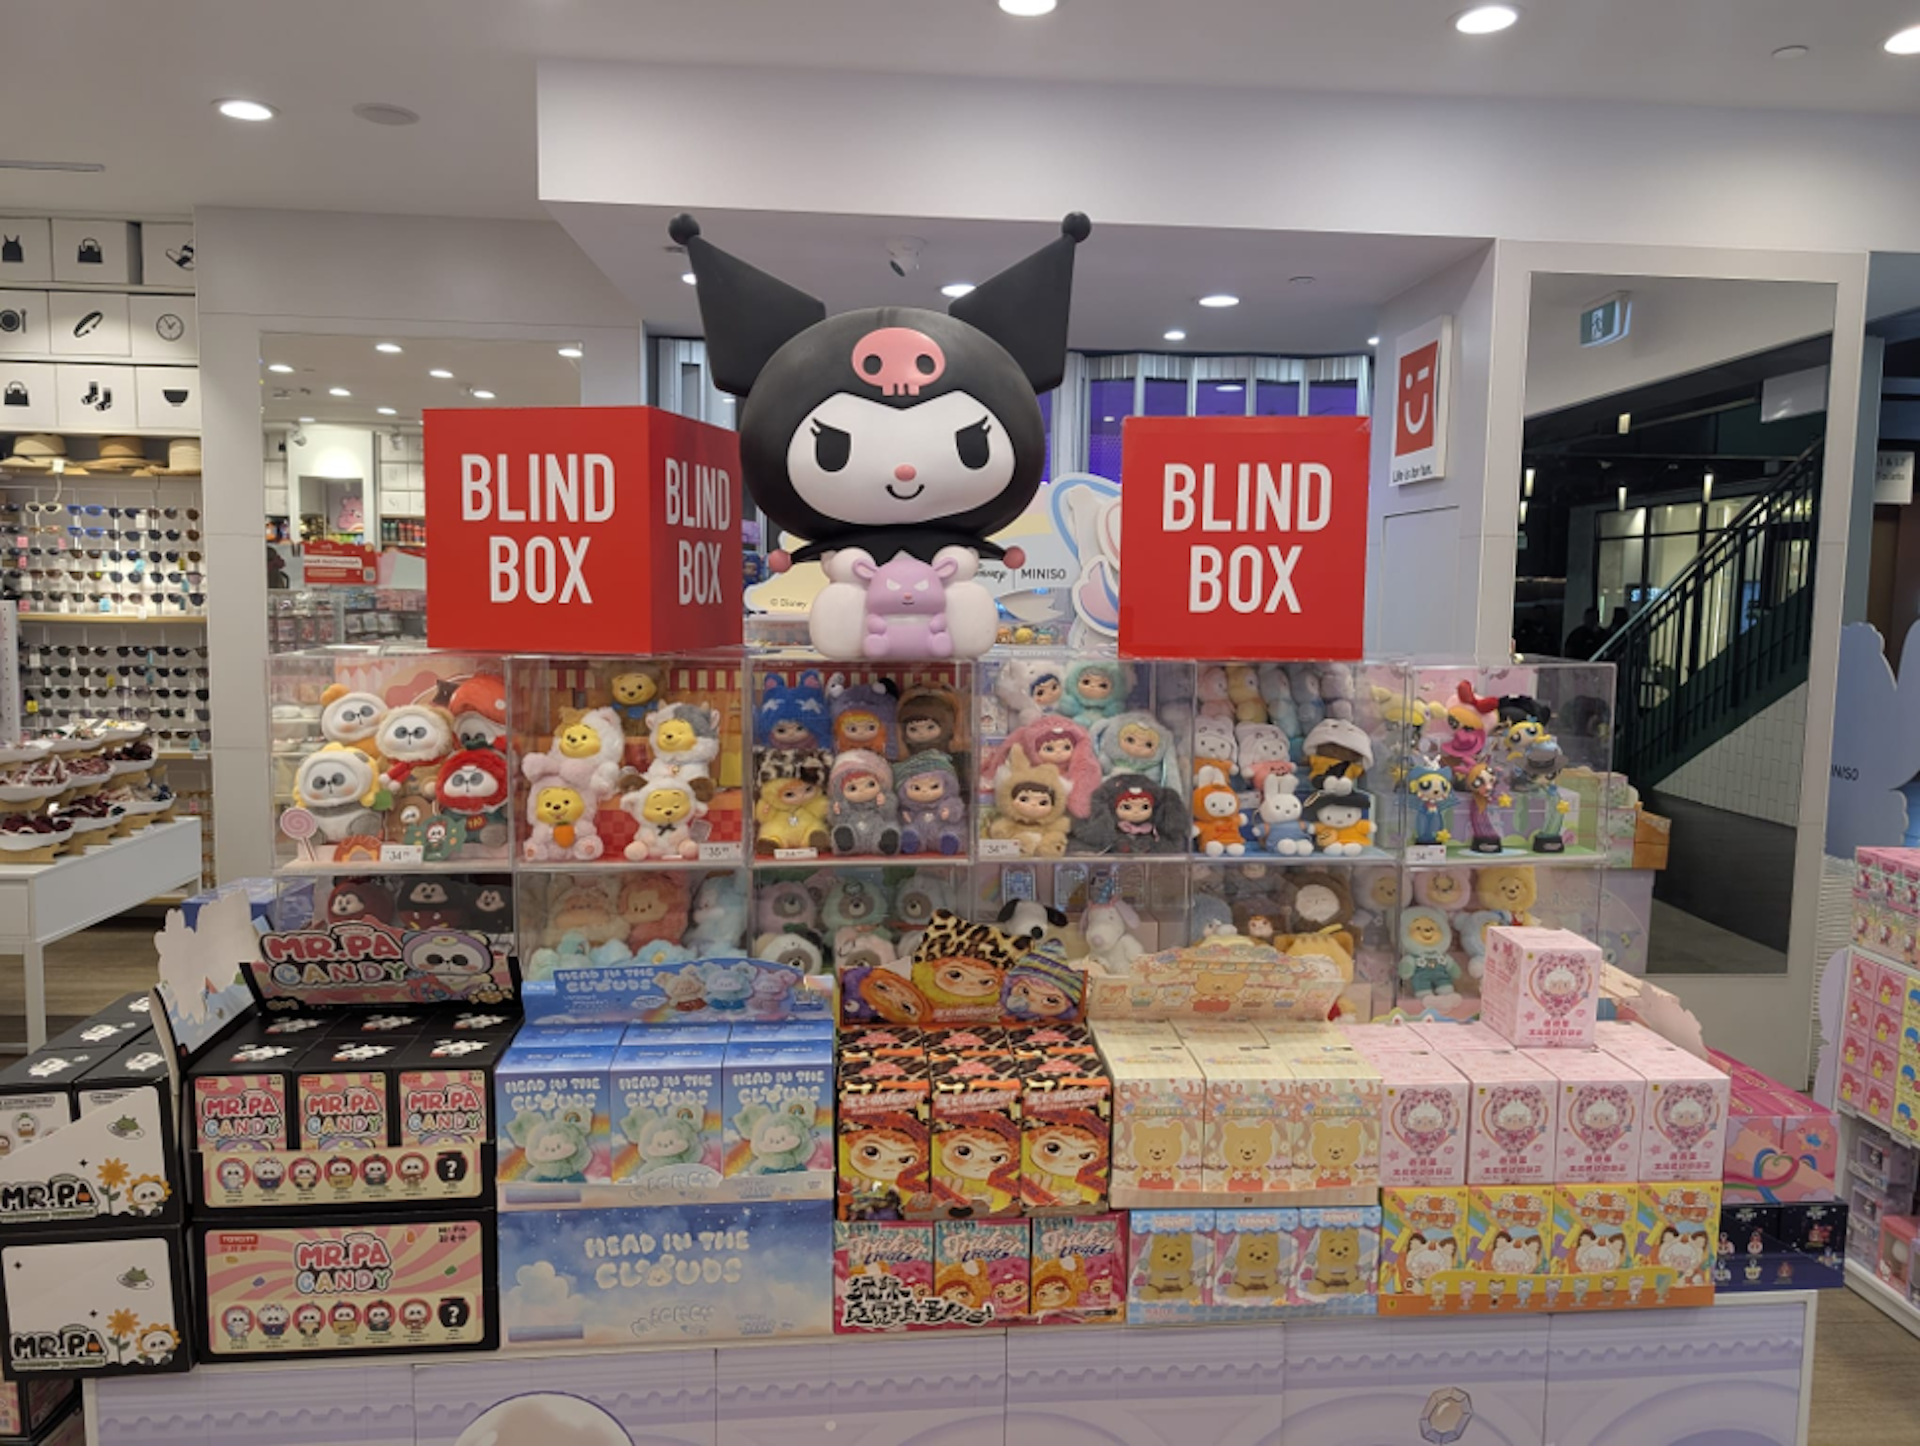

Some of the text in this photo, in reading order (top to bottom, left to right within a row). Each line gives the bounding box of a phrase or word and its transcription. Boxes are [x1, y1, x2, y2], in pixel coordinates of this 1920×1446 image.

[461, 453, 615, 522] BLIND
[665, 457, 731, 531] BLIND
[1162, 463, 1332, 532] BLIND
[489, 535, 592, 603] BOX
[678, 539, 722, 605] BOX
[1021, 568, 1067, 580] MINISO
[1188, 545, 1302, 613] BOX
[266, 932, 402, 962] MR.PA
[274, 962, 407, 986] CANDY
[624, 967, 655, 979] THE
[505, 1077, 601, 1094] HEAD IN THE
[618, 1074, 713, 1091] HEAD IN THE
[732, 1070, 825, 1087] HEAD IN THE
[205, 1096, 278, 1116] MR.PA
[307, 1092, 381, 1114] MR.PA
[408, 1090, 479, 1111] MR.PA
[204, 1117, 281, 1137] CANDY
[307, 1115, 382, 1135] CANDY
[407, 1112, 481, 1132] CANDY
[299, 1242, 390, 1268] MR.PA
[584, 1230, 750, 1259] HEAD IN THE
[299, 1270, 391, 1293] CANDY
[14, 1334, 104, 1358] MR.PA
